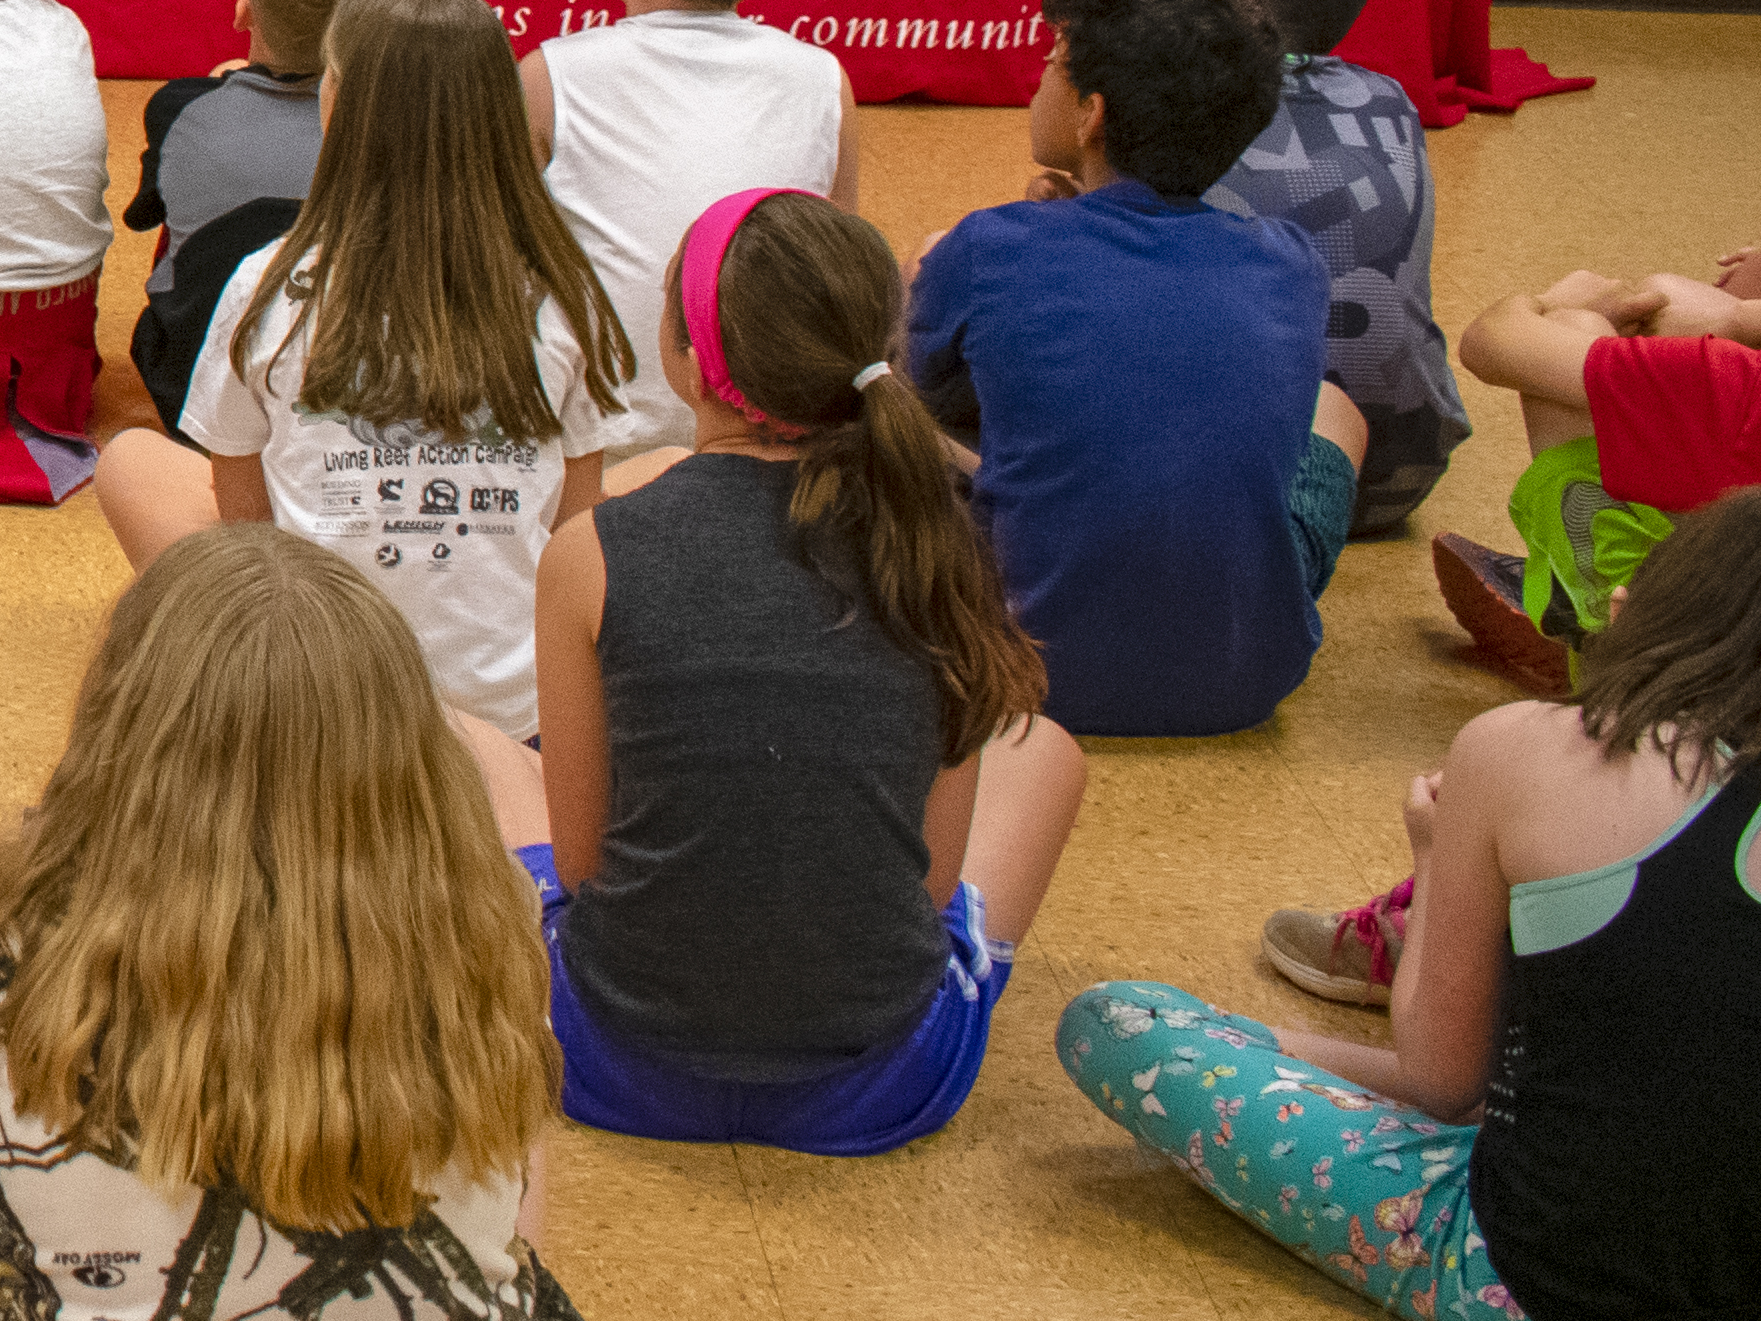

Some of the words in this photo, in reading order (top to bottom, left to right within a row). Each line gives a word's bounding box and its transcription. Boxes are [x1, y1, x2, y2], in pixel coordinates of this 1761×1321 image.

[788, 4, 1048, 55] communit
[323, 449, 369, 472] Living
[373, 445, 411, 468] Reef
